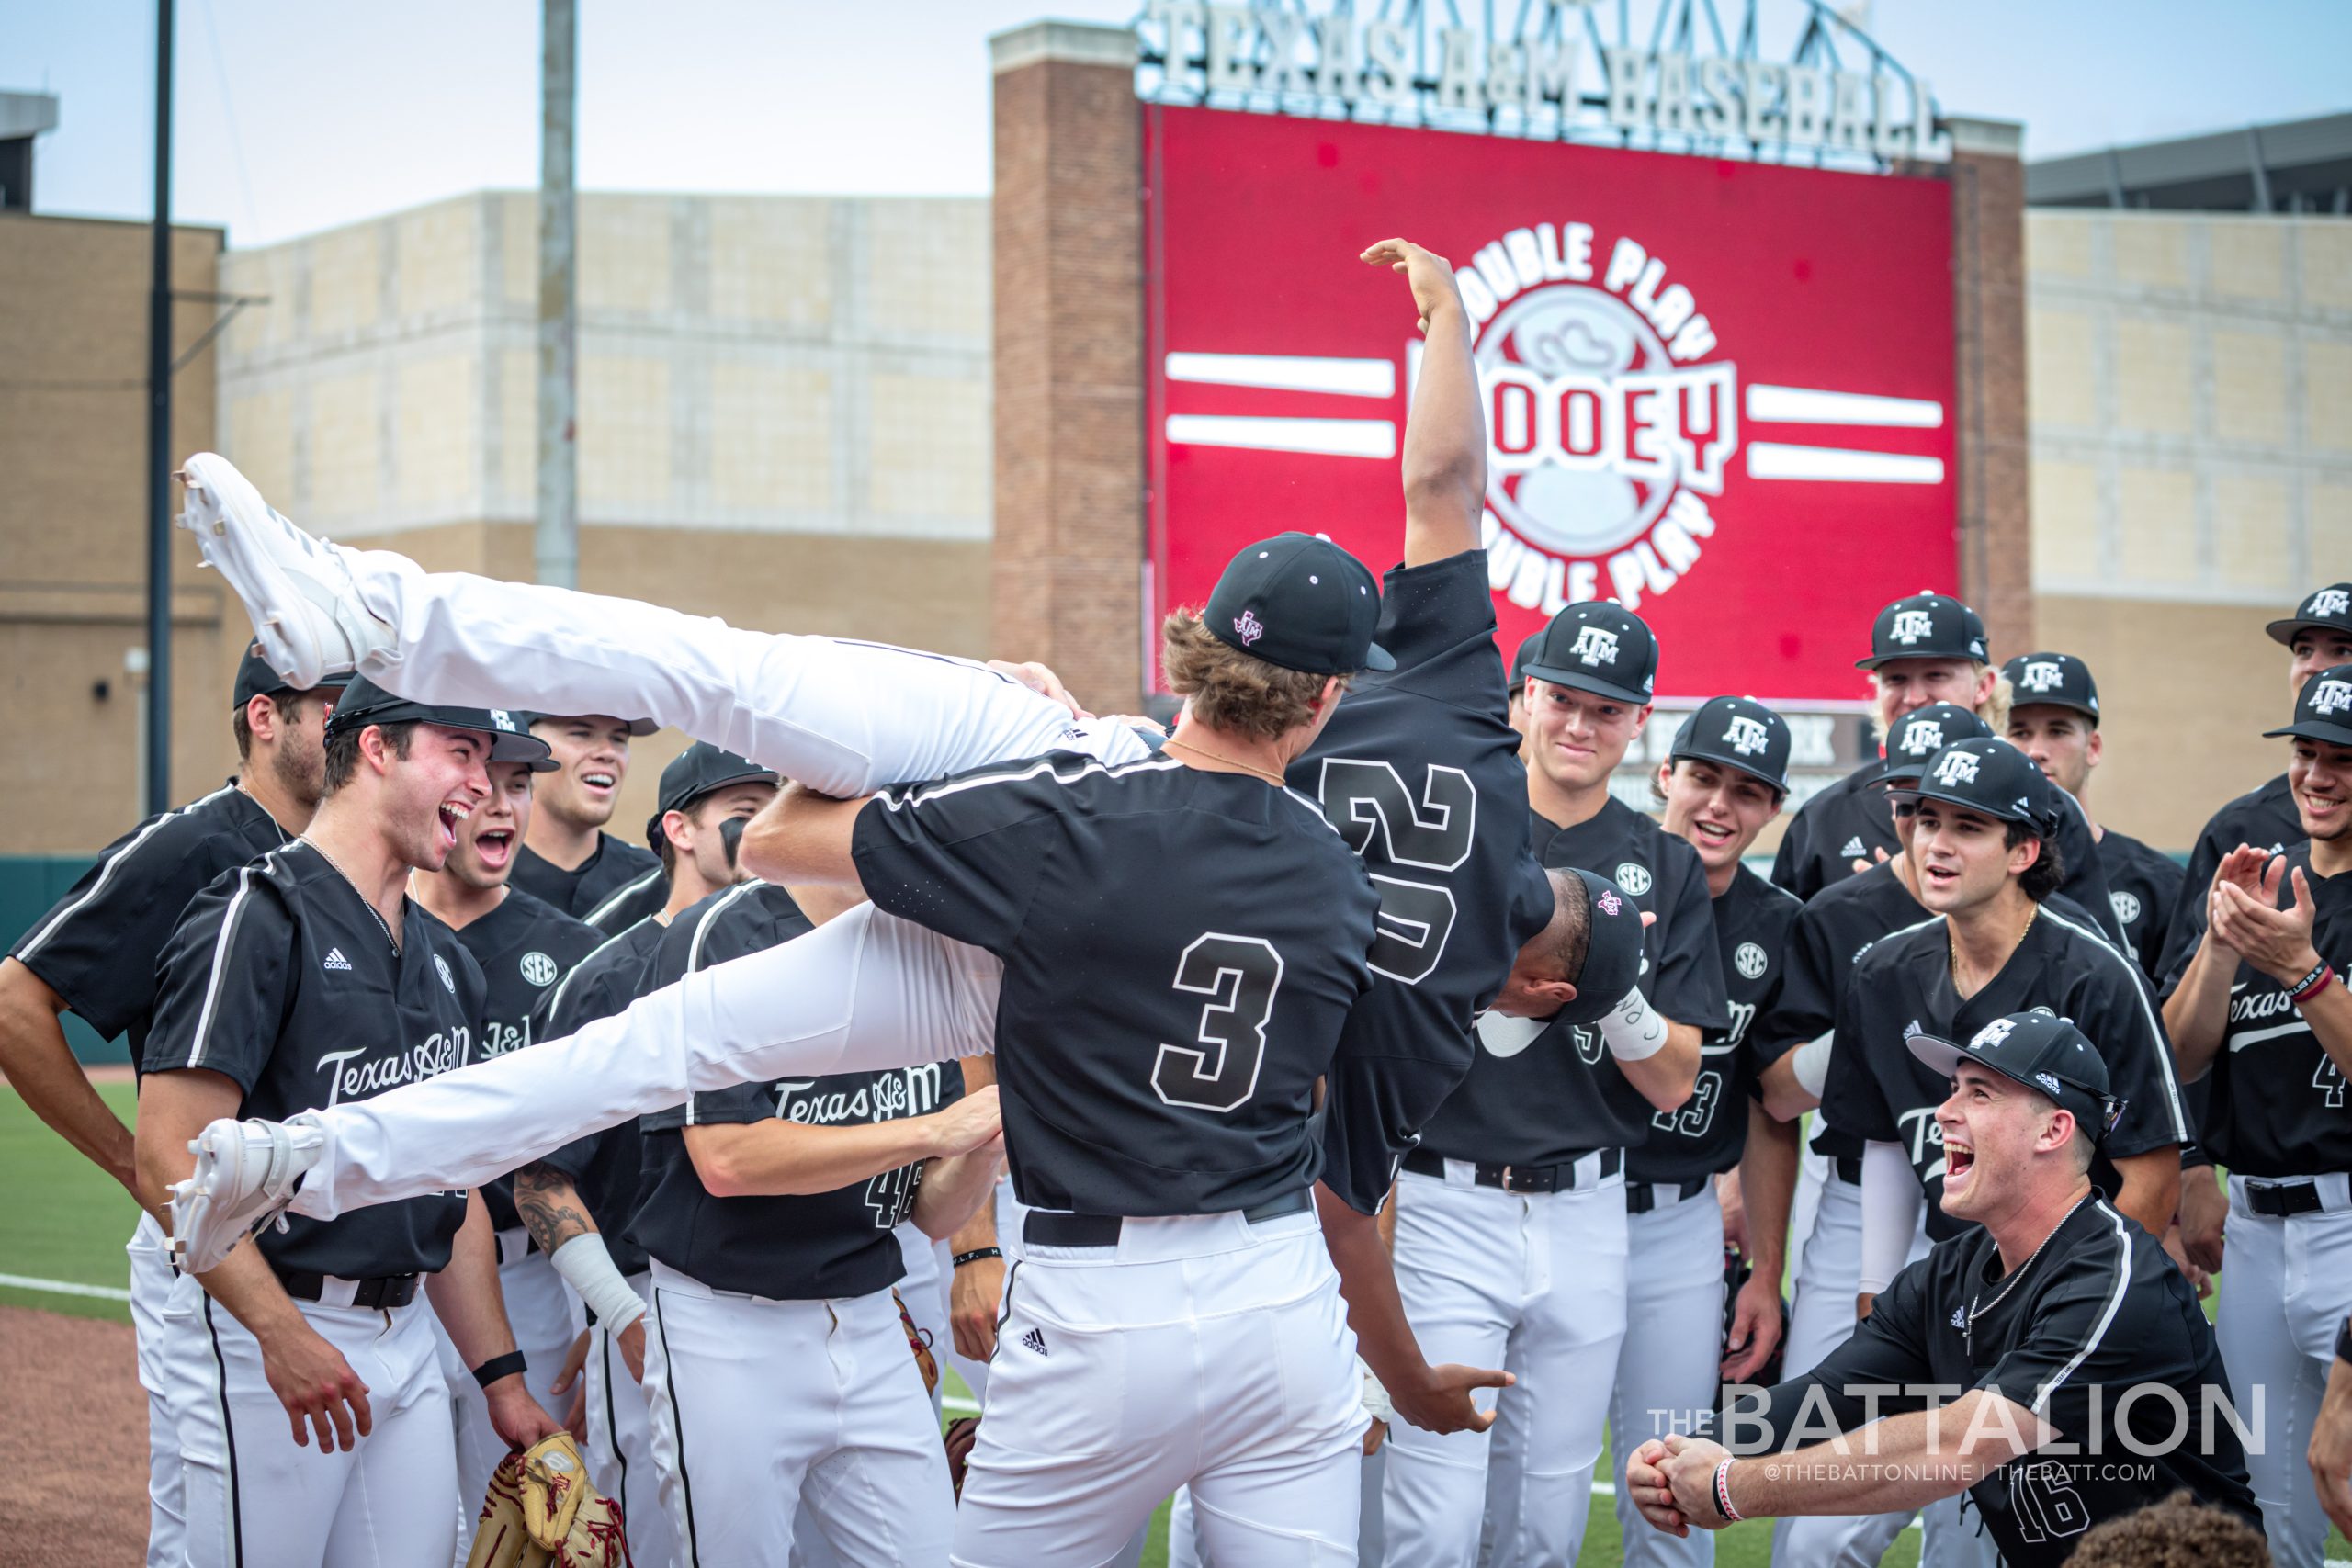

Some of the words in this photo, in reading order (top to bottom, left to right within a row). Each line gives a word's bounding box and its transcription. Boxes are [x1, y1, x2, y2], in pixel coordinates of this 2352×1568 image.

[1147, 0, 1413, 106] TEXAS
[1436, 28, 1580, 119] A&M
[1604, 46, 1952, 163] BASEBALL
[1454, 221, 1594, 345] OUBLE
[1604, 236, 1717, 360] PLAY
[1607, 489, 1716, 611] PLAY
[1617, 864, 1650, 893] SEC
[323, 960, 353, 971] adidas
[524, 960, 556, 984] SEC
[1736, 945, 1766, 976] SEC
[1149, 931, 1284, 1113] 3
[2231, 982, 2290, 1023] exas
[316, 1047, 412, 1108] Texas
[775, 1080, 869, 1125] Texas
[872, 1062, 941, 1123] A&M
[2035, 1073, 2061, 1095] adidas
[1022, 1338, 1048, 1357] adidas
